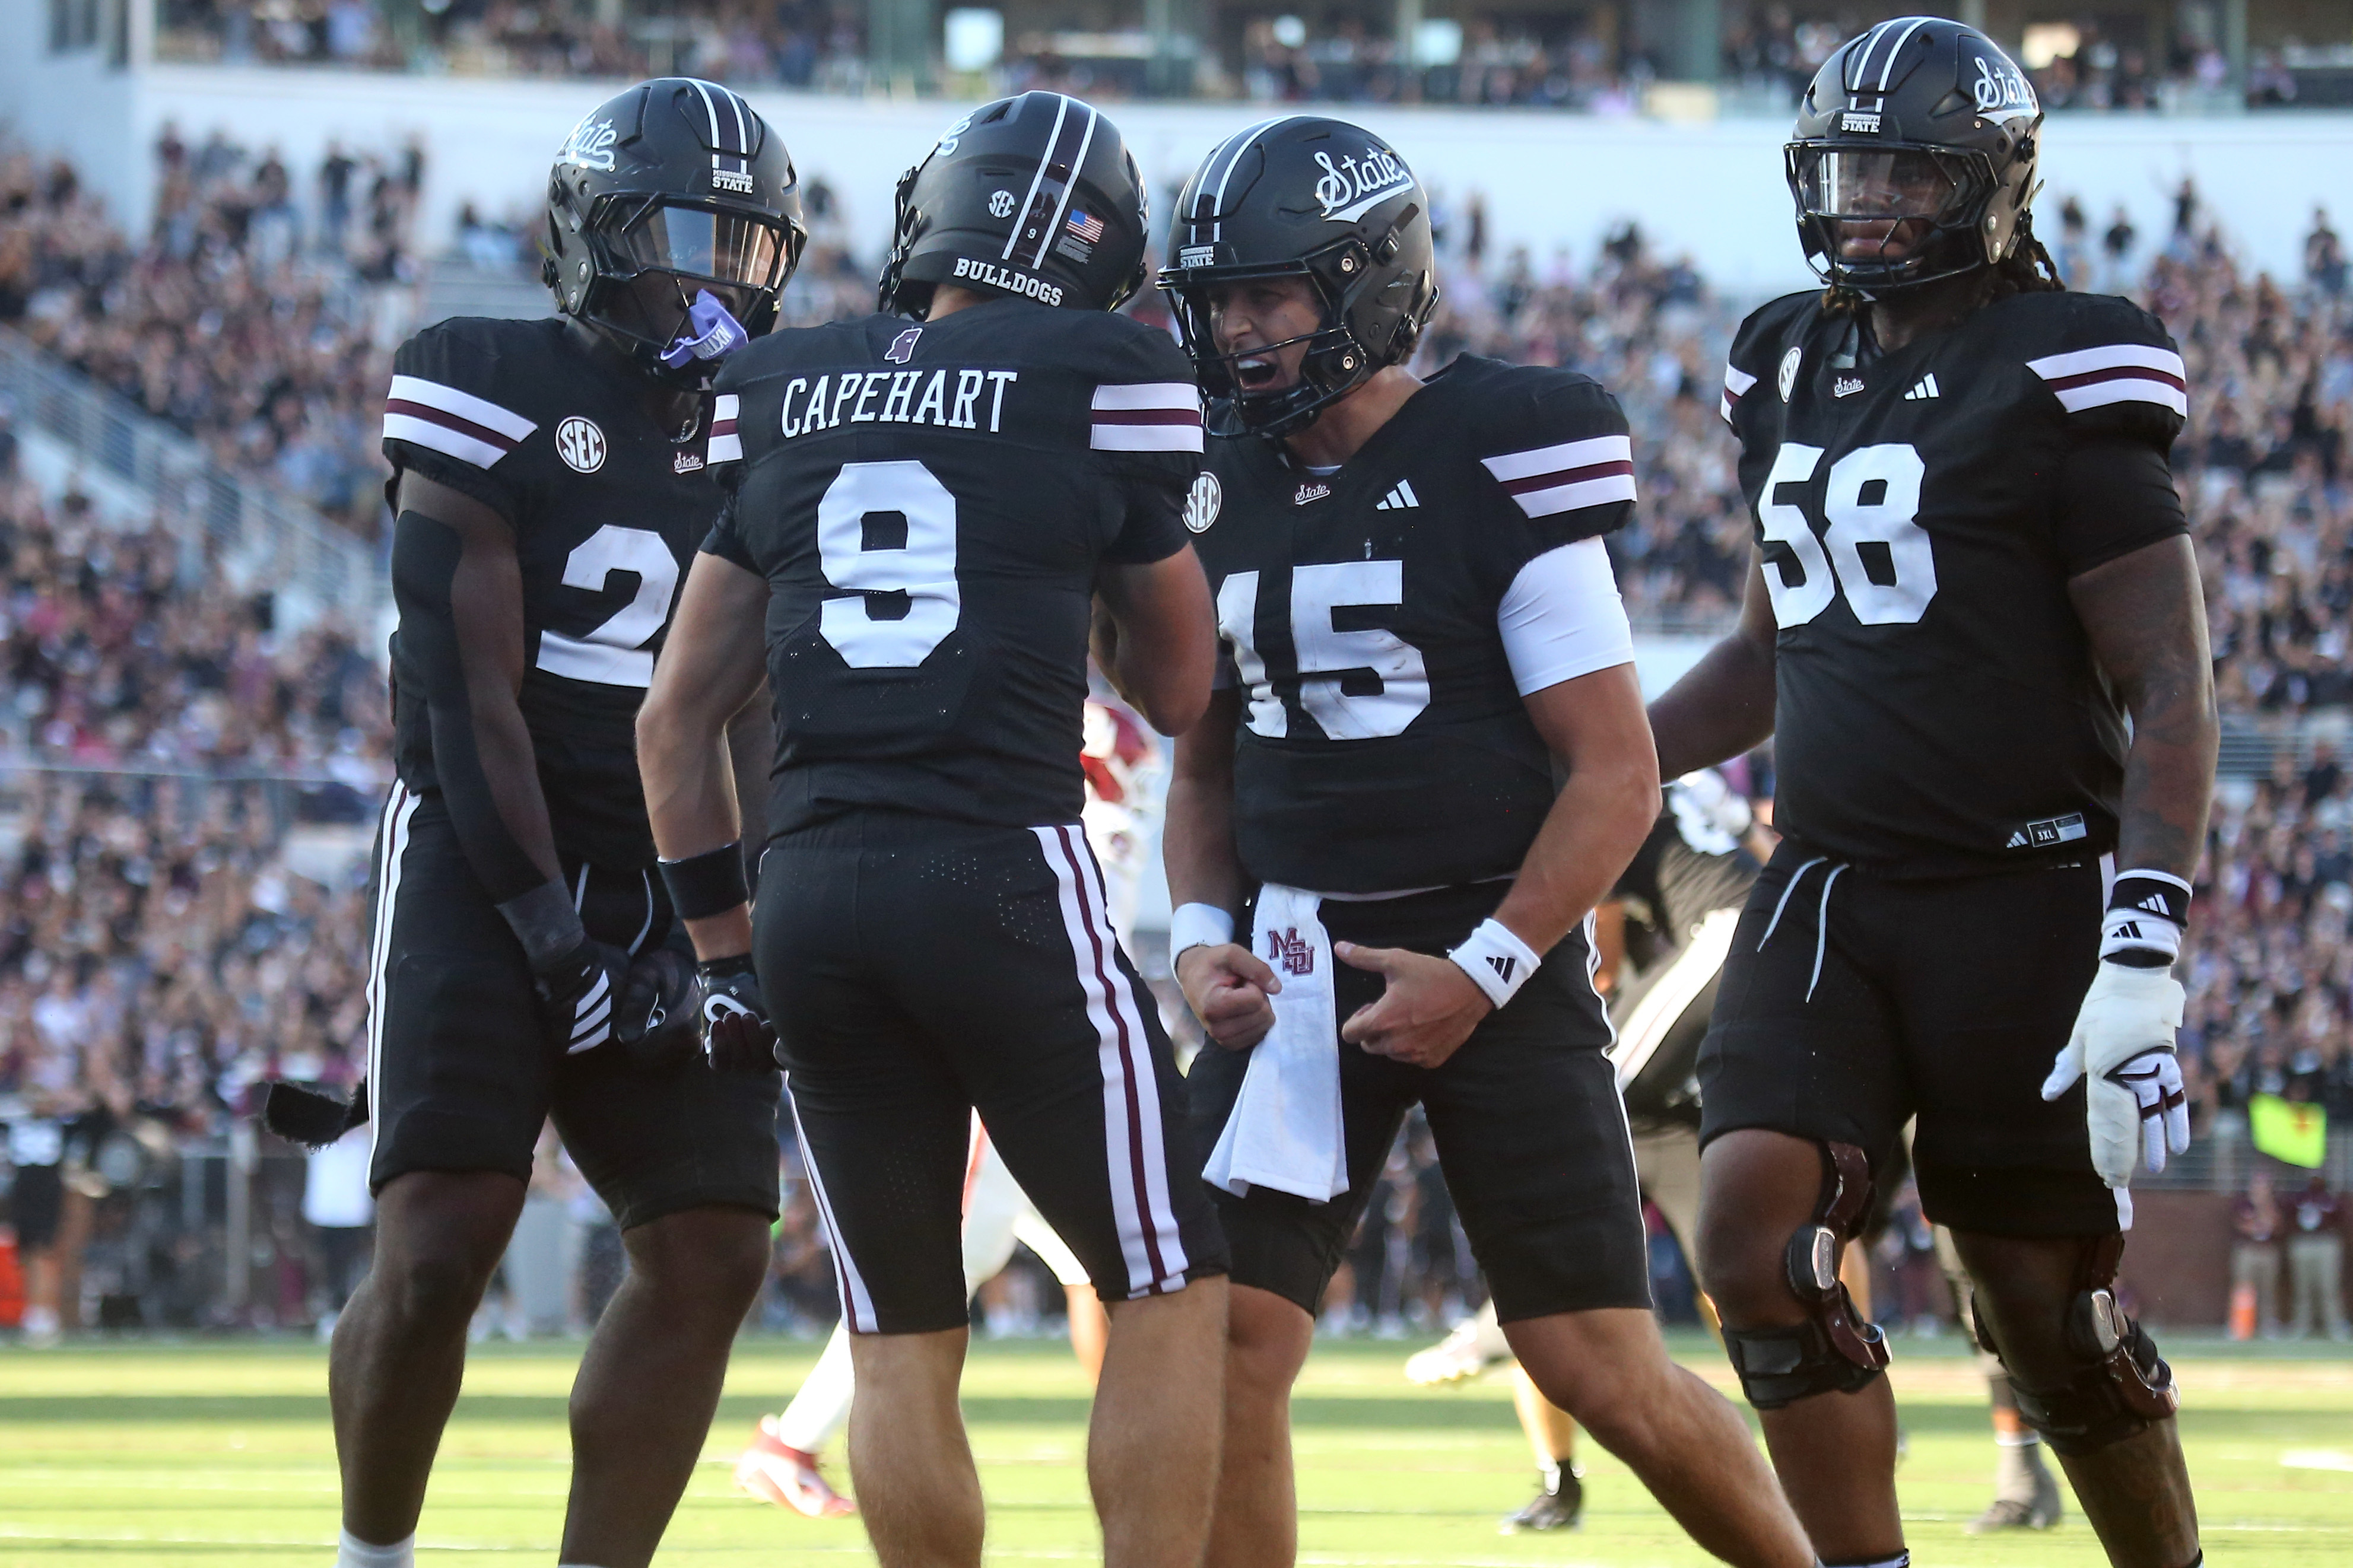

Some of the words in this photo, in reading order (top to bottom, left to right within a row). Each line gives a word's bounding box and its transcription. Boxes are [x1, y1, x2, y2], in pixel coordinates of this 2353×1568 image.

[1974, 57, 2040, 122] Stat
[1841, 120, 1881, 133] STATE
[712, 176, 753, 194] STATE
[988, 189, 1015, 218] SEC
[1313, 148, 1414, 223] State
[1027, 228, 1037, 239] 9
[953, 257, 1063, 307] BULLDOGS
[1180, 253, 1214, 269] STATE
[782, 369, 1018, 438] CAPEHART
[1834, 377, 1864, 398] State
[559, 421, 602, 469] SEC
[674, 452, 704, 475] State
[1186, 476, 1217, 528] SEC
[1295, 484, 1330, 505] State
[1758, 442, 1938, 630] 58
[818, 460, 961, 669] 9
[535, 523, 679, 688] 2
[1217, 560, 1430, 740] 15
[2037, 830, 2054, 841] 3XL
[1268, 928, 1314, 976] MSU
